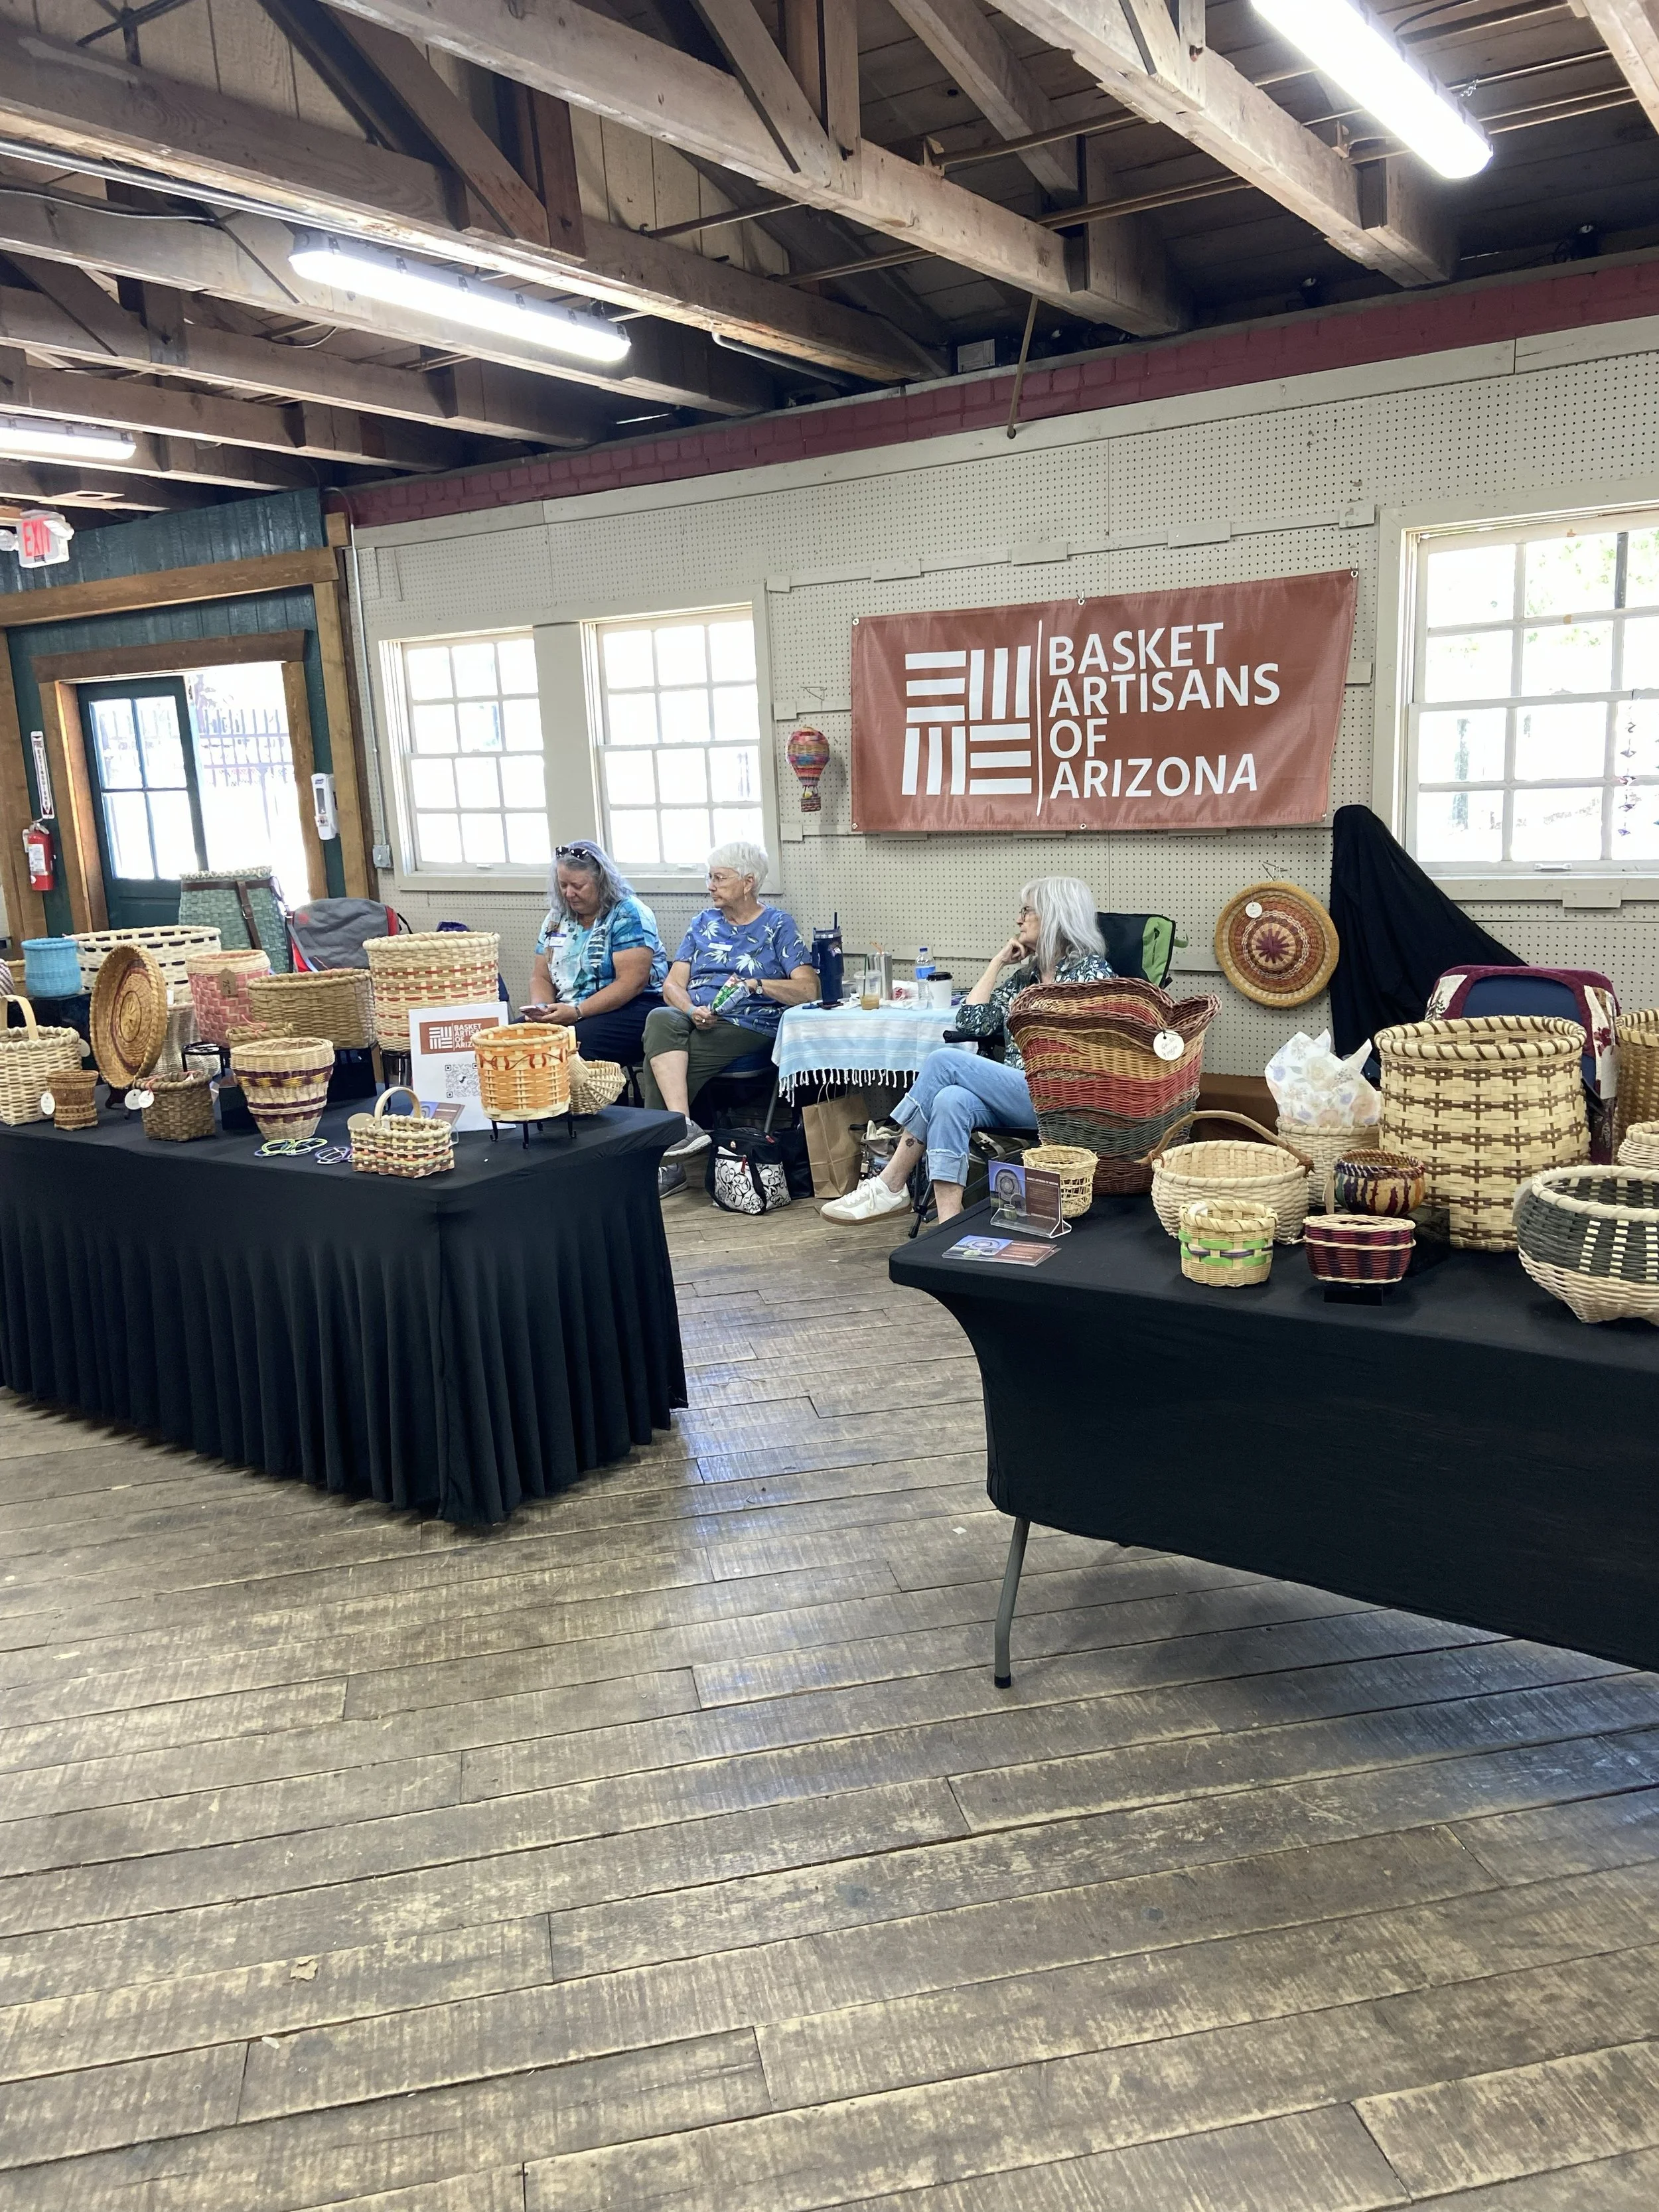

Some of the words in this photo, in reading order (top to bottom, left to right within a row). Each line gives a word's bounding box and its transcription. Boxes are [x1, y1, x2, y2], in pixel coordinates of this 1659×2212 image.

[1048, 622, 1224, 676] BASKET
[1048, 662, 1281, 719] ARTISANS
[1049, 718, 1108, 759] OF
[1049, 753, 1258, 799] ARIZONA
